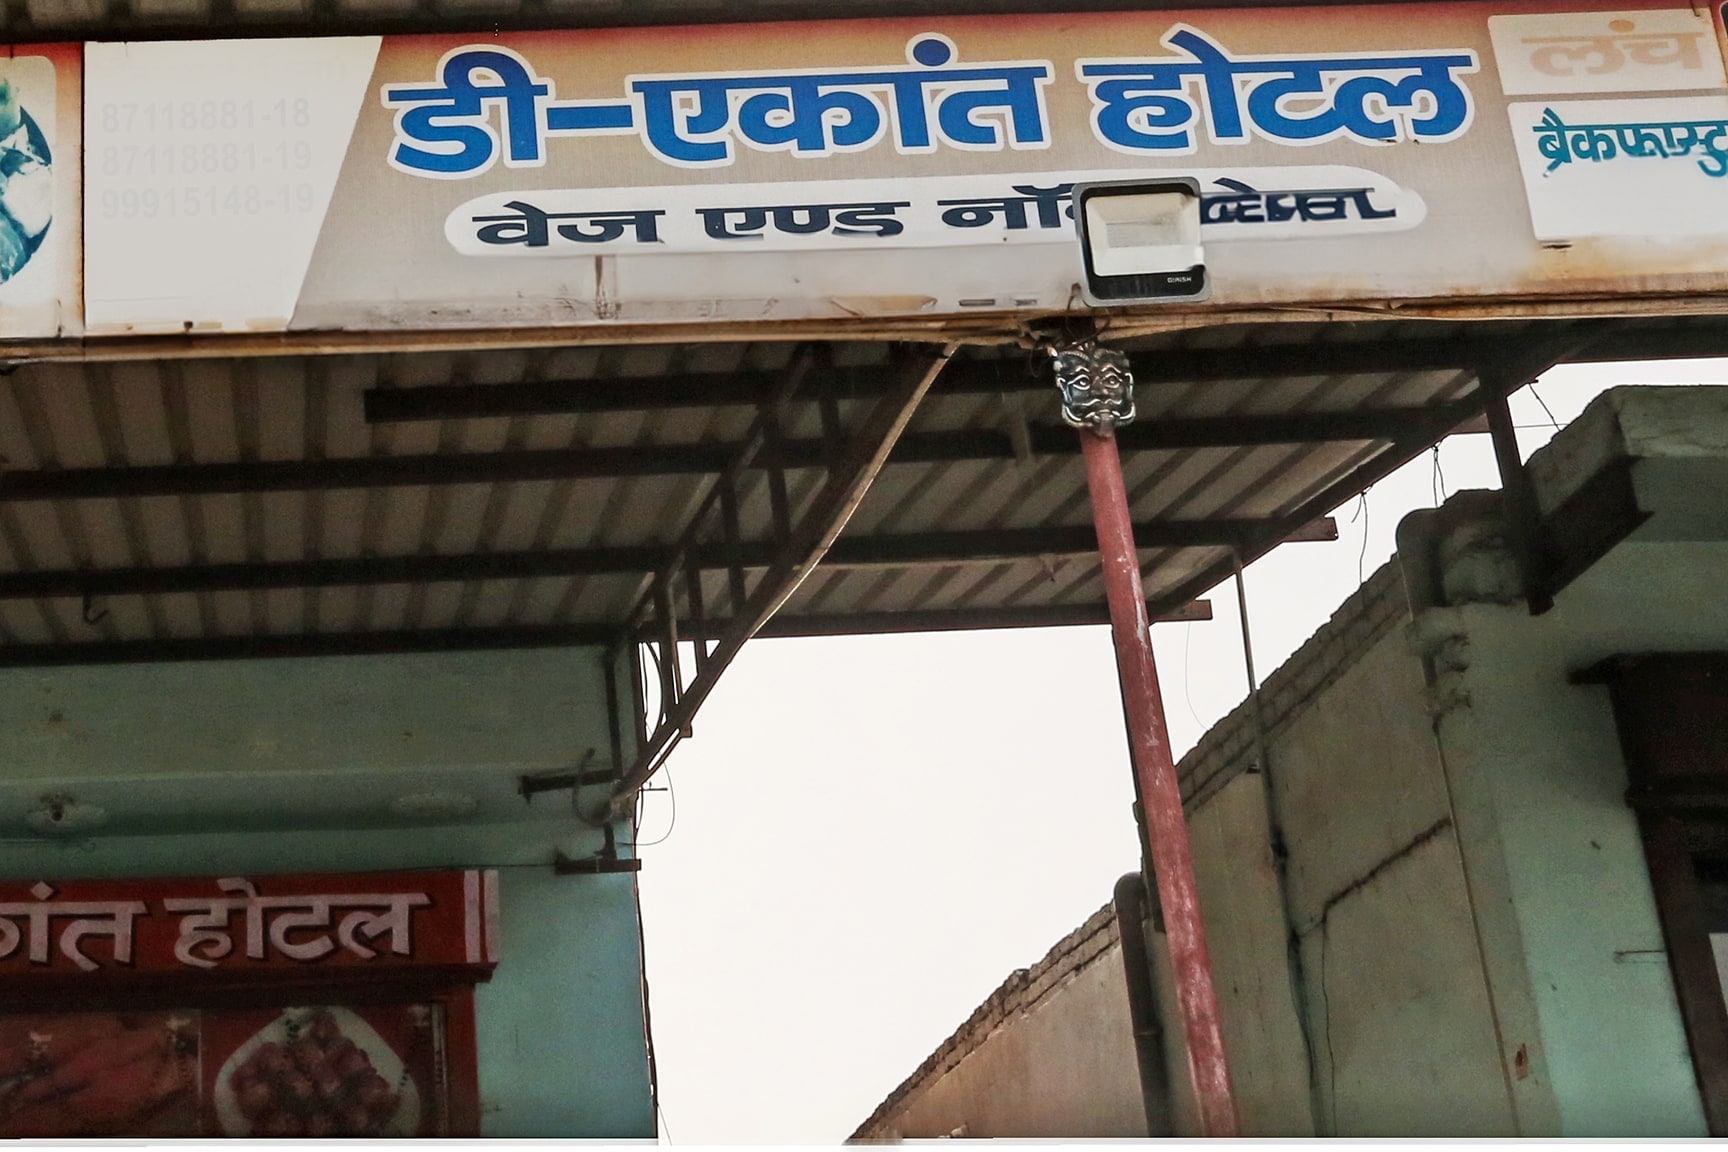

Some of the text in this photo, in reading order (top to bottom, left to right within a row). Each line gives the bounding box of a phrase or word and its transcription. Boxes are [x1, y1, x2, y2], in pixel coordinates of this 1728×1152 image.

[387, 39, 1048, 174] डी-एकांत
[472, 200, 667, 248] वेज
[694, 200, 912, 241] एण्ड
[163, 877, 431, 969] होटल
